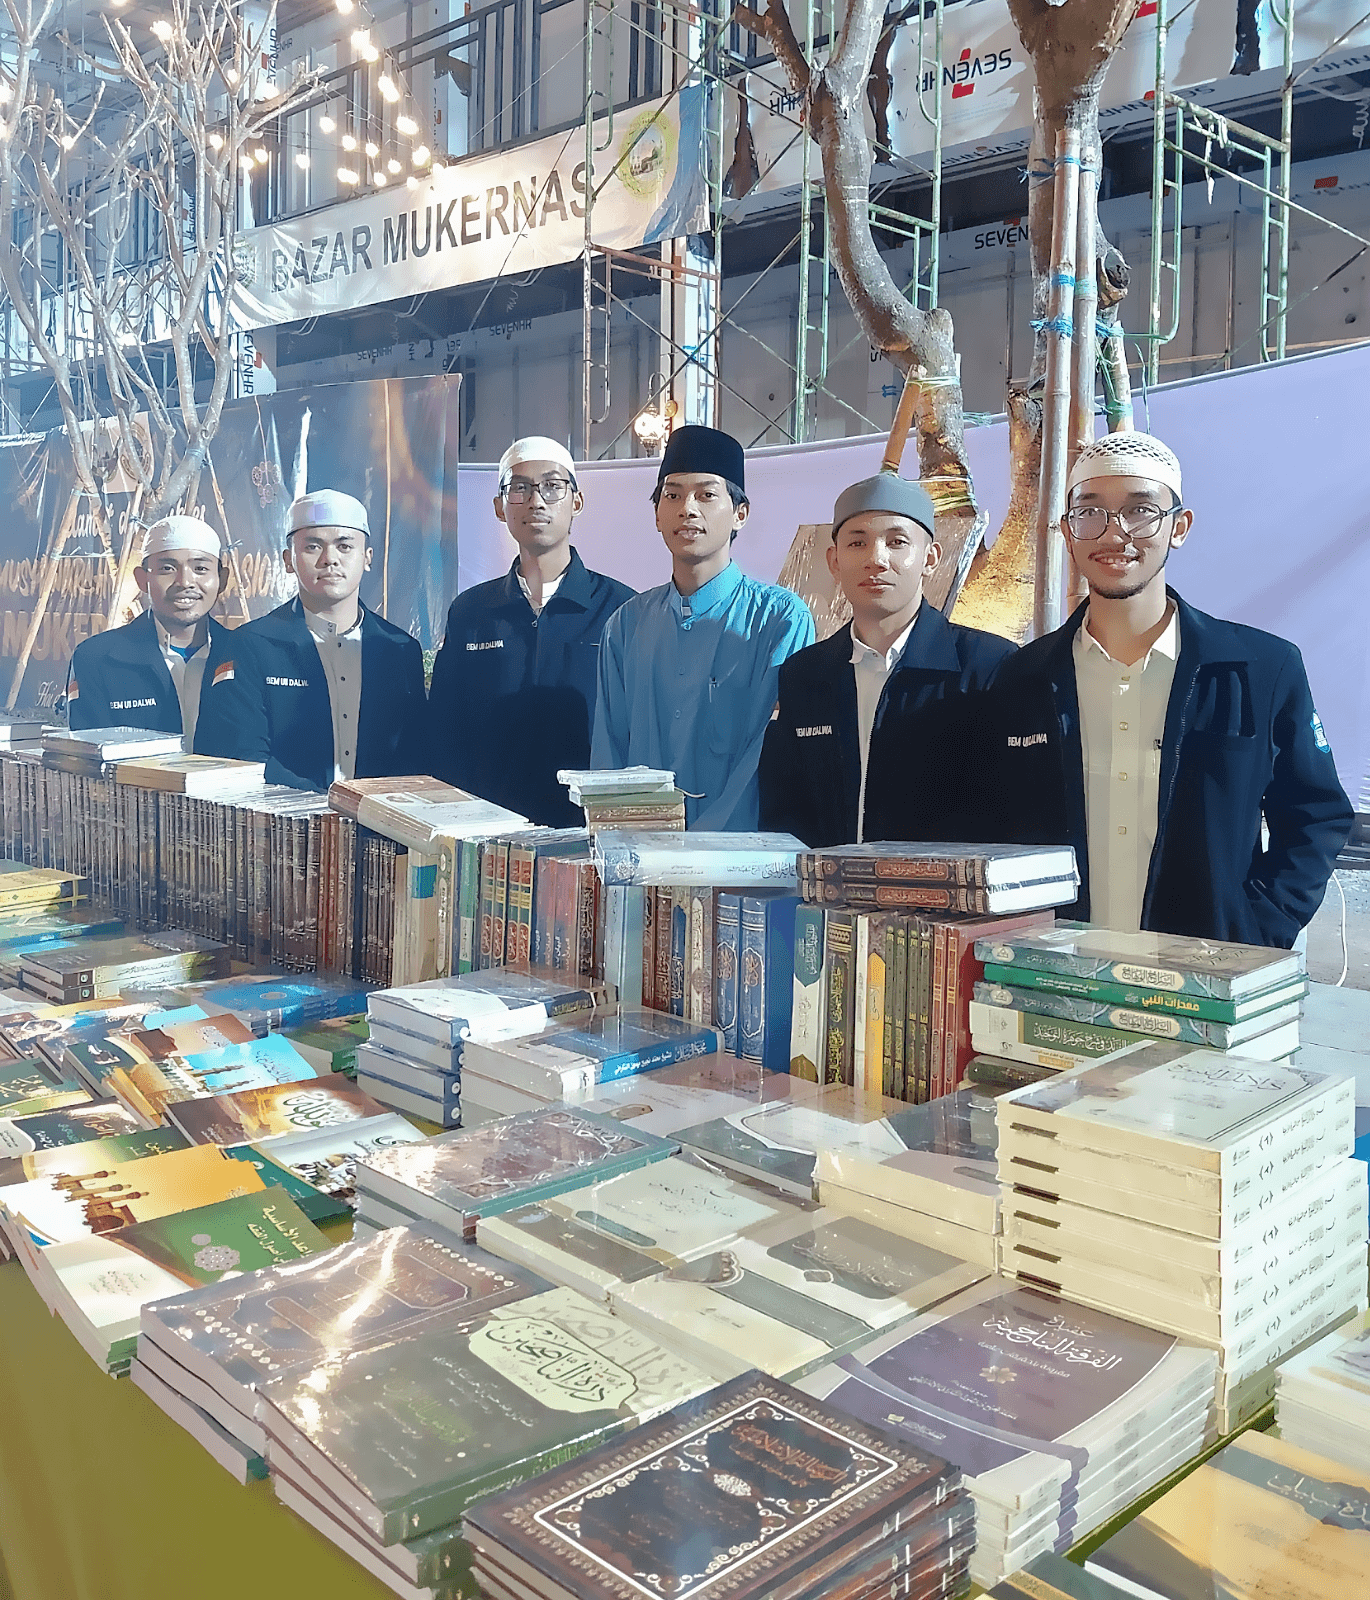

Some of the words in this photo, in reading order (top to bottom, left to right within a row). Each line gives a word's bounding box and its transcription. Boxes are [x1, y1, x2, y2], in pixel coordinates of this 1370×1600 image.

[270, 224, 373, 294] BAZAR
[382, 161, 597, 266] MUKERNAS
[243, 330, 254, 395] EVENHR
